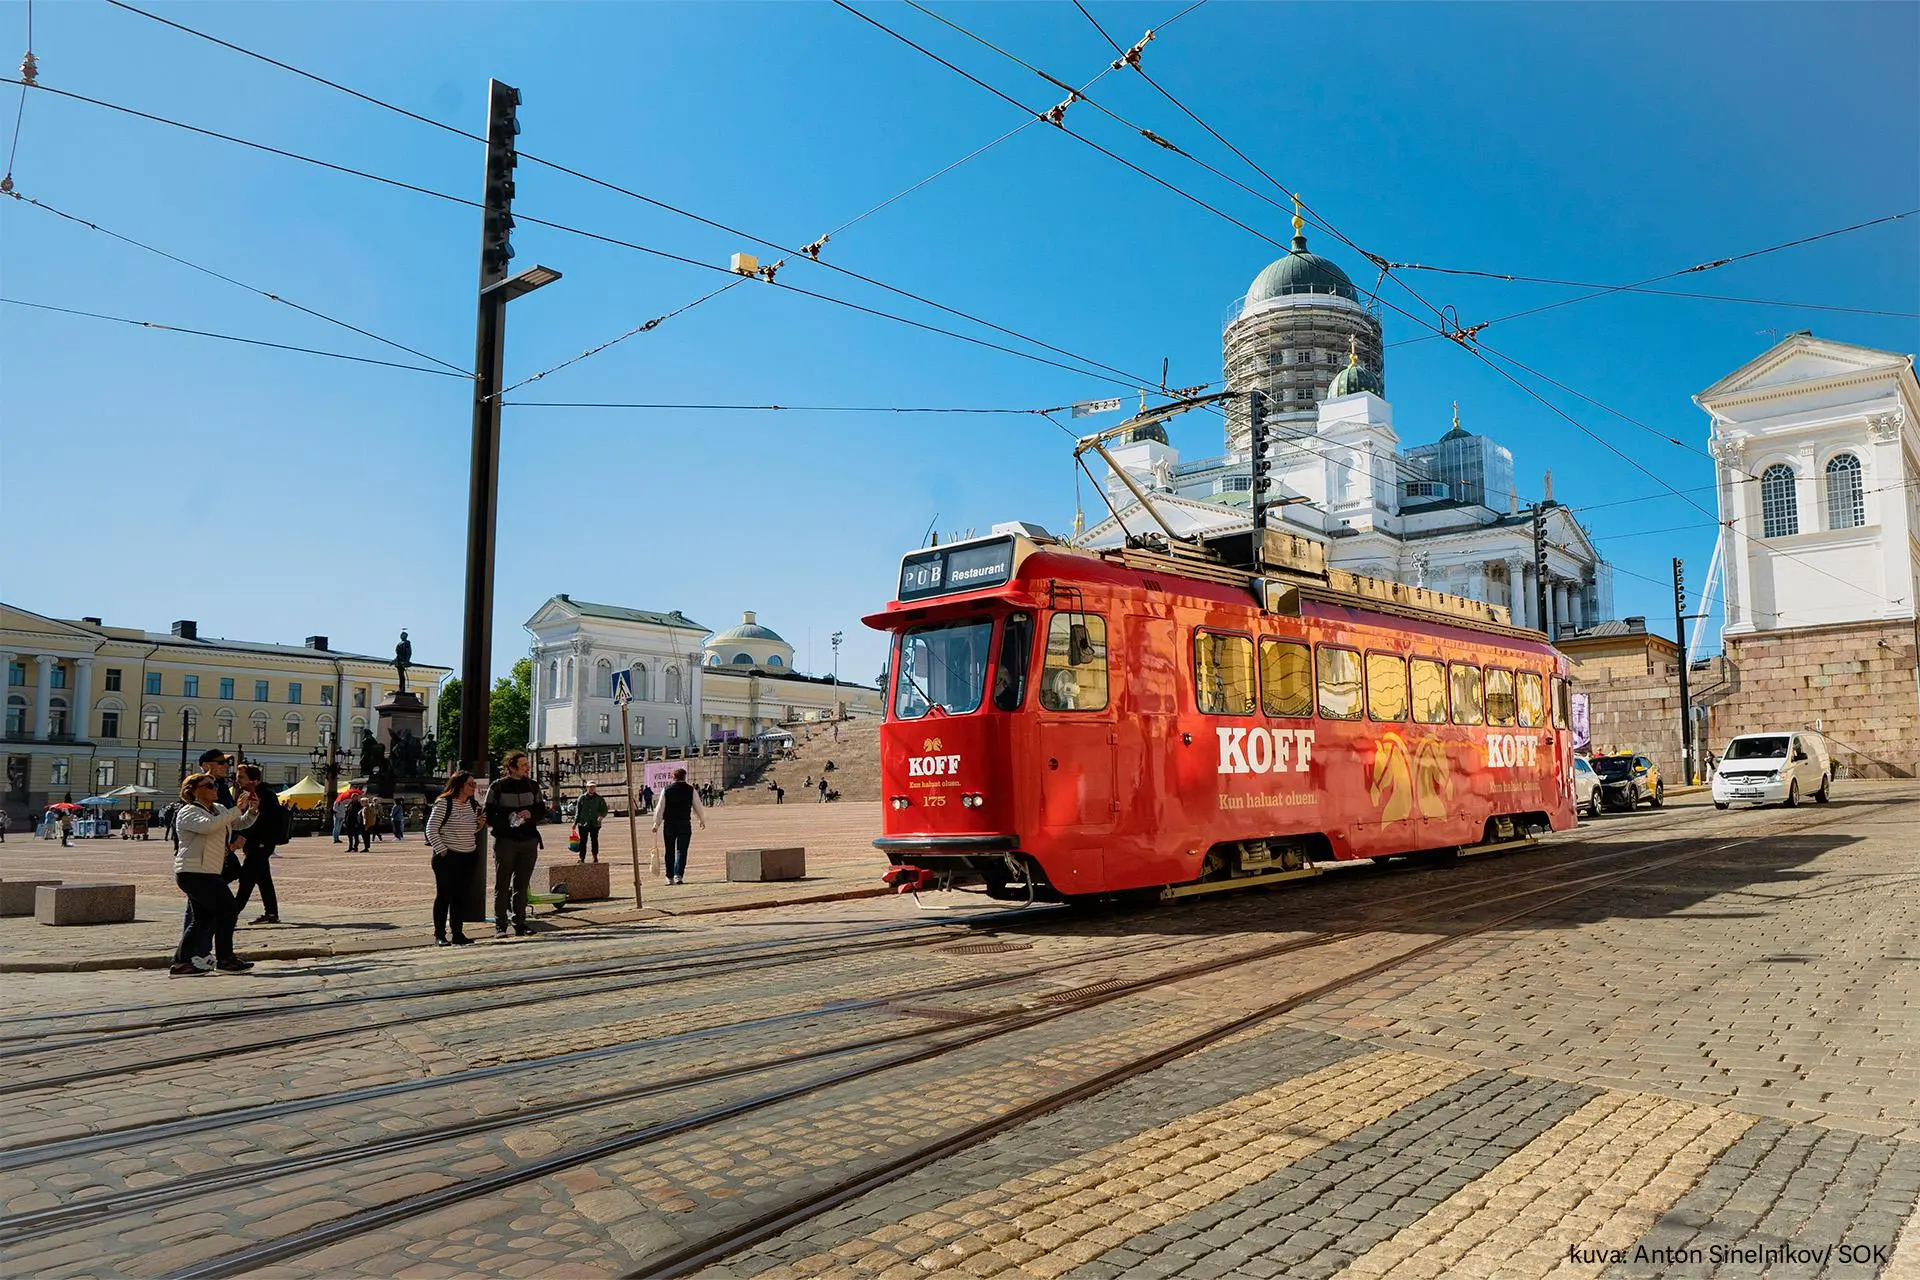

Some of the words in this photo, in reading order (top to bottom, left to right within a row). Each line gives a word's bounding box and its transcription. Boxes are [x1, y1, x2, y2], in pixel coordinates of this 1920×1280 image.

[905, 566, 942, 587] PUB
[951, 562, 1005, 581] Restaurant
[1216, 727, 1316, 774] KOFF
[1486, 734, 1538, 768] KOFF
[908, 754, 961, 777] KOFF
[923, 796, 946, 807] 175
[1219, 793, 1244, 810] Kun
[1246, 791, 1283, 808] haluat
[1285, 790, 1318, 805] oluen.
